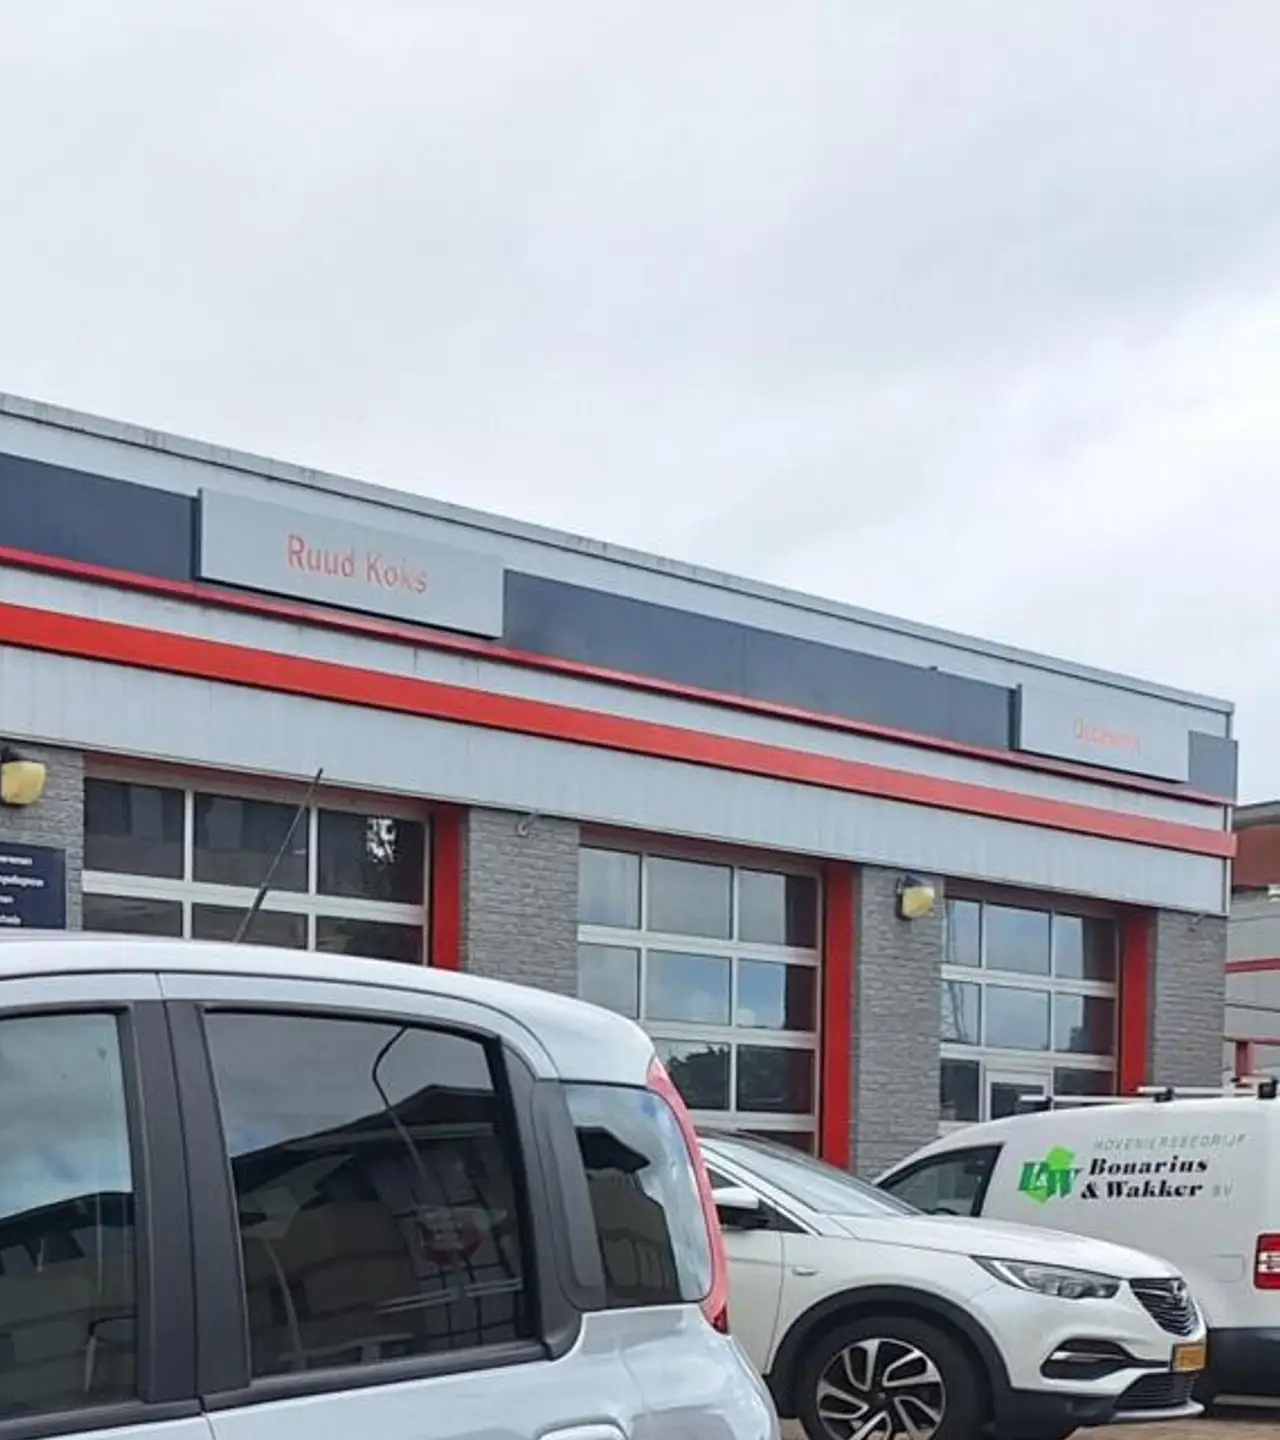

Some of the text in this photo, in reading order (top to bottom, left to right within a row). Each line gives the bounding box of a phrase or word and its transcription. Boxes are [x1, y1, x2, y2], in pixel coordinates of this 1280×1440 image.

[288, 534, 428, 593] Ruud Koks
[1107, 1179, 1204, 1199] Wakker
